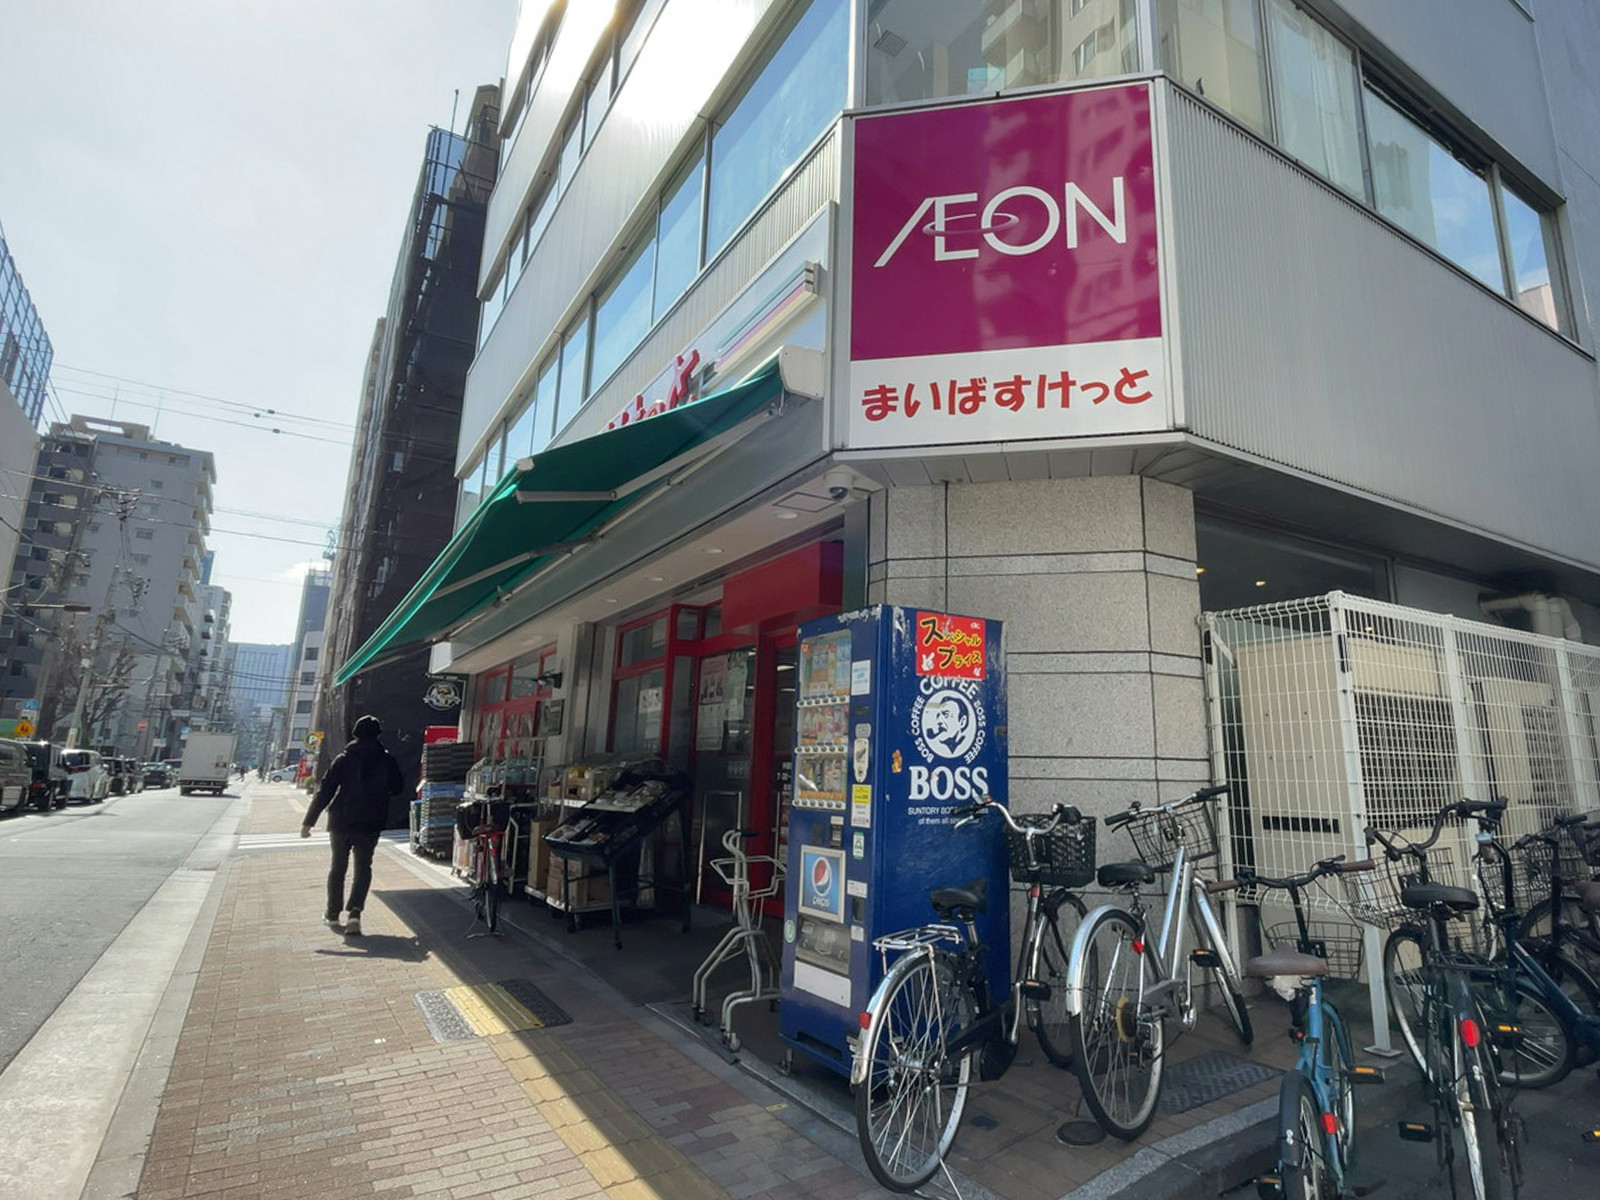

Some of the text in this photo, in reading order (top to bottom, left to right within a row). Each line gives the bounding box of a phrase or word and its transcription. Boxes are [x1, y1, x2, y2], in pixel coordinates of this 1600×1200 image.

[861, 367, 1154, 422] まいばすけっと
[937, 645, 982, 669] プライス
[911, 695, 934, 763] BOSS COFFEE
[964, 700, 986, 764] BOSS COFFEE
[908, 765, 989, 804] BOSS
[908, 806, 939, 815] SUNTORY
